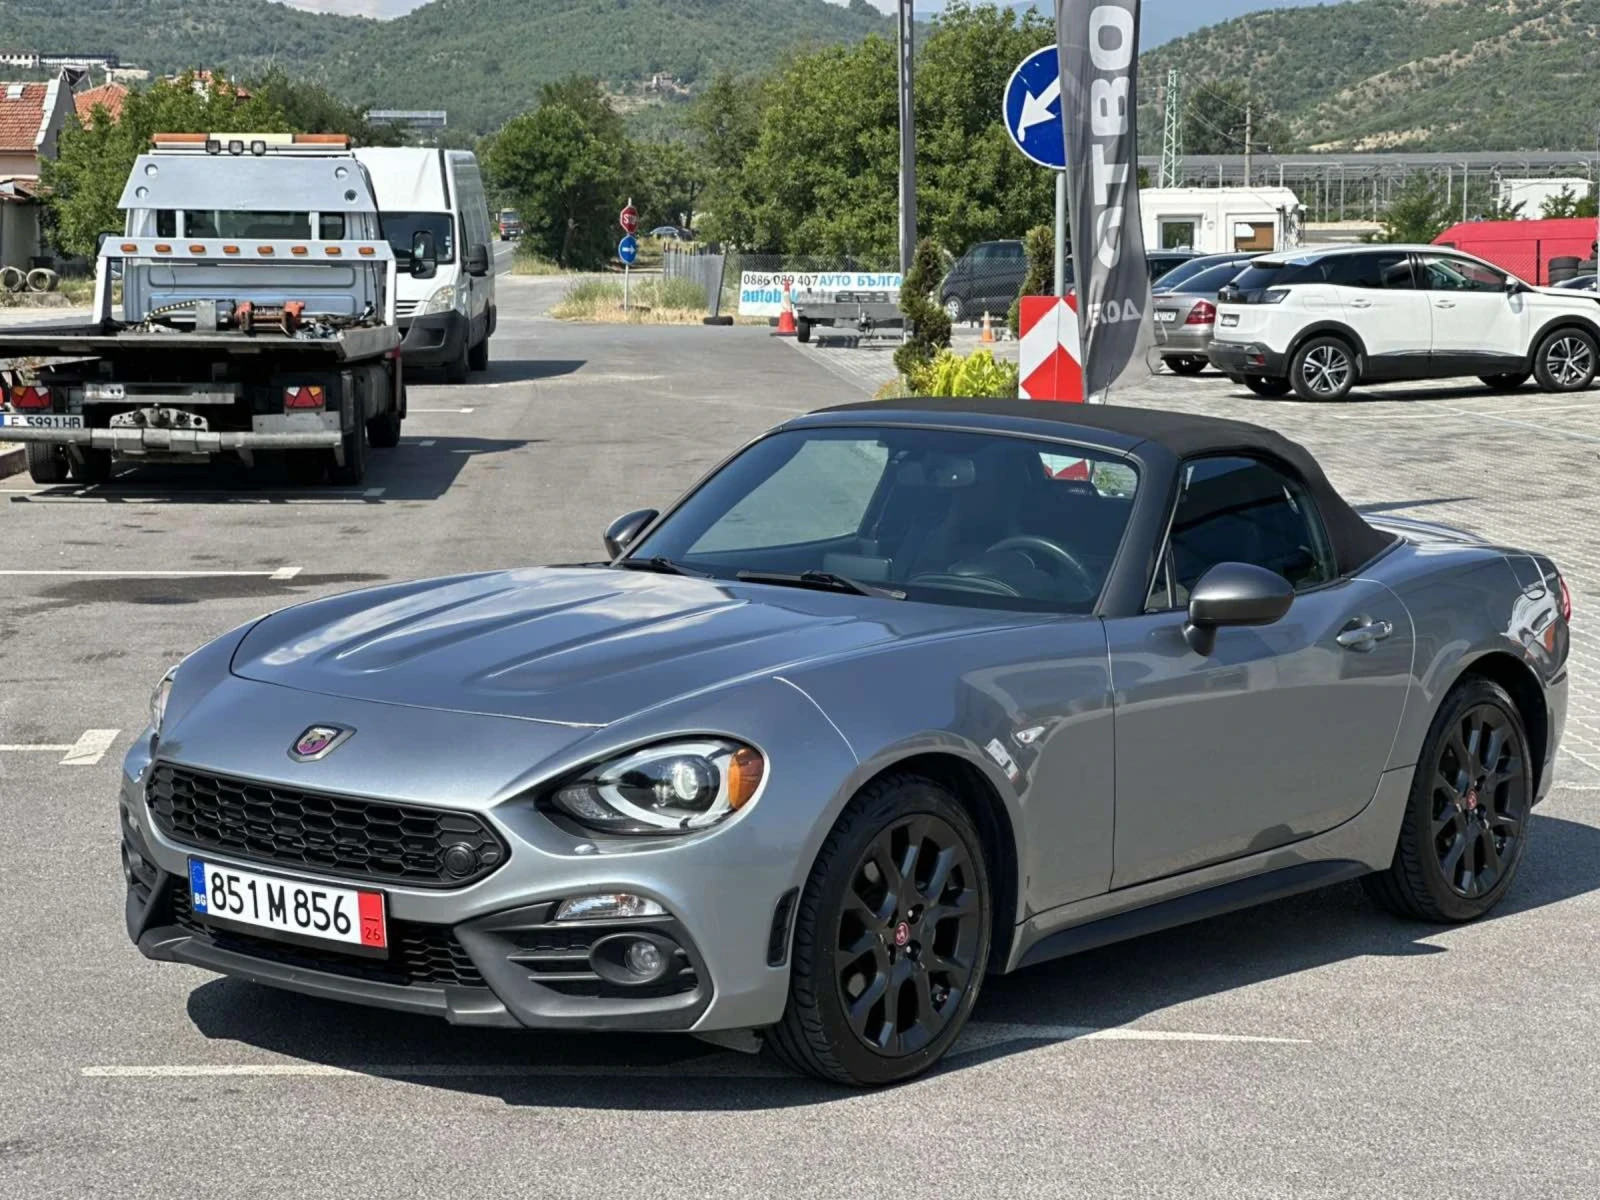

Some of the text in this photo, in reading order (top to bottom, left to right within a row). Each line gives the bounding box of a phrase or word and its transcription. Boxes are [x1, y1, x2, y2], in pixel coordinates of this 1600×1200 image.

[743, 274, 770, 286] 0886
[798, 275, 818, 286] 407
[819, 275, 851, 287] АУТО
[26, 416, 59, 428] 5991
[194, 893, 206, 906] BG
[266, 882, 288, 925] M
[293, 889, 351, 935] 856
[365, 927, 381, 941] 26
